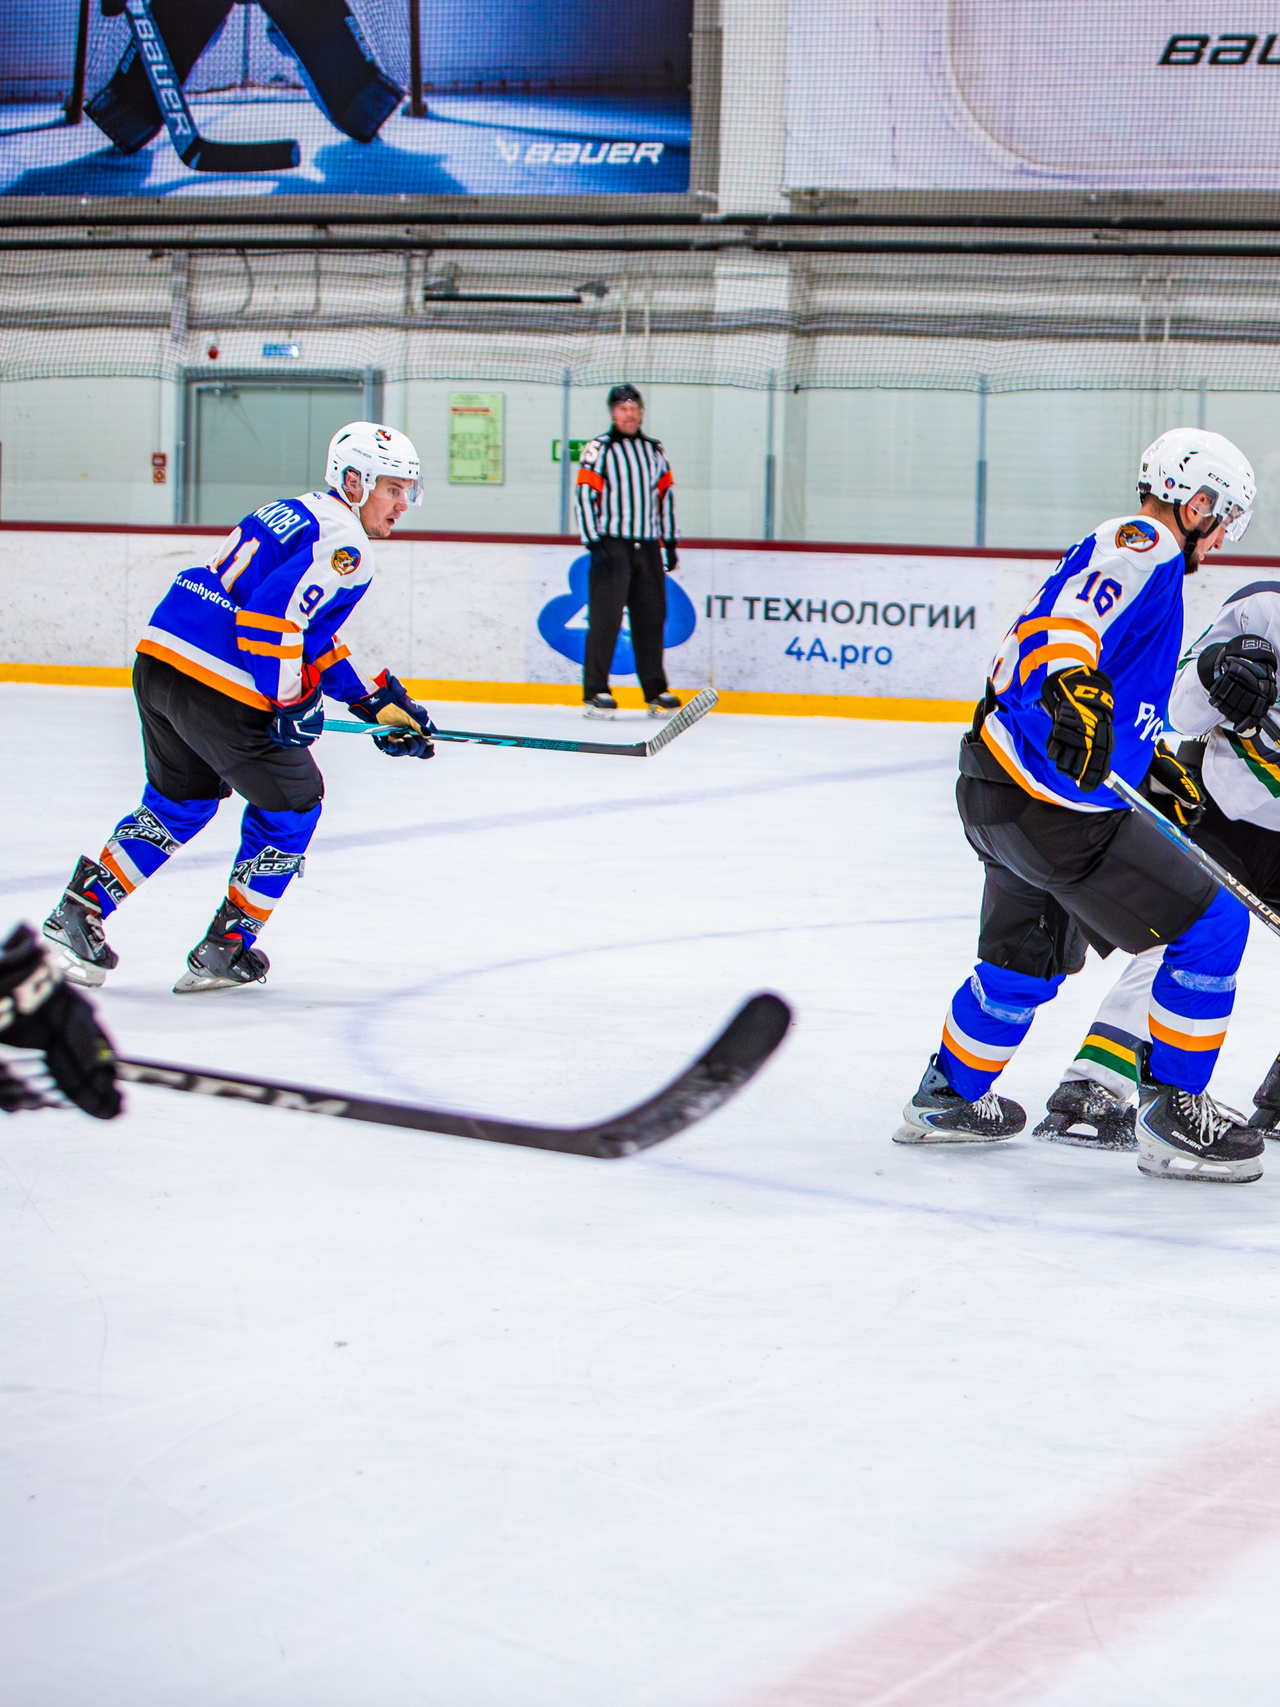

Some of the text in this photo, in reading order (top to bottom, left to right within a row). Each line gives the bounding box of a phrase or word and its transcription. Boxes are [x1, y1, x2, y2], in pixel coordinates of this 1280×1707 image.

[134, 18, 192, 137] BAUER
[523, 142, 666, 165] BAUER
[1075, 570, 1123, 618] 16
[742, 596, 976, 630] ТЕХНОЛОГИИ
[784, 635, 893, 670] 4A.pro
